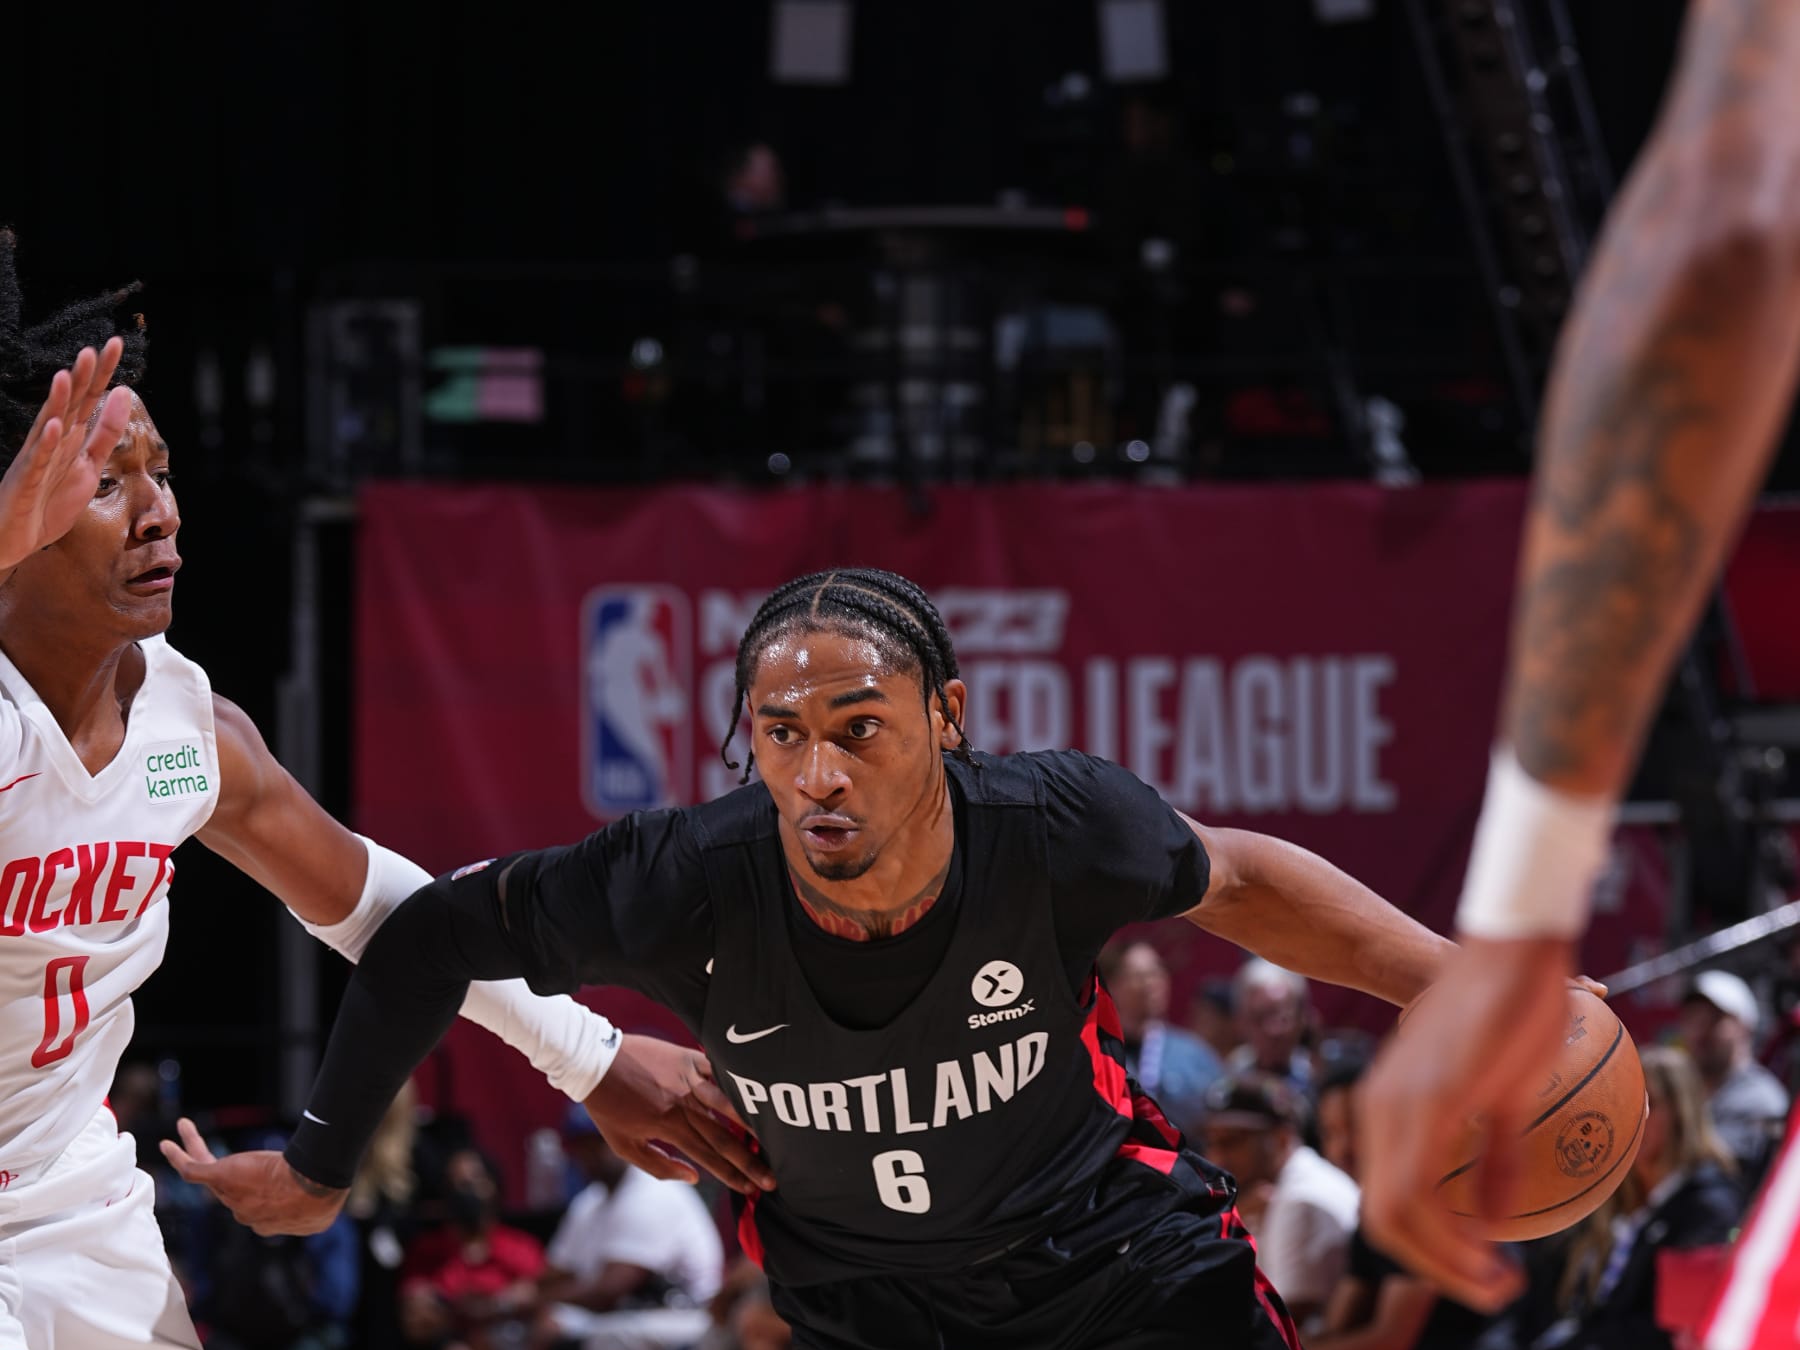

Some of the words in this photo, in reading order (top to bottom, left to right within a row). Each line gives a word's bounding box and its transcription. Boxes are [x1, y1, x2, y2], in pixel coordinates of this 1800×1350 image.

[146, 773, 208, 798] karma
[147, 745, 200, 772] credit
[0, 841, 175, 936] OCKET
[31, 956, 90, 1069] 0
[968, 999, 1036, 1029] StormX
[726, 1032, 1049, 1134] PORTLAND
[872, 1150, 931, 1214] 6
